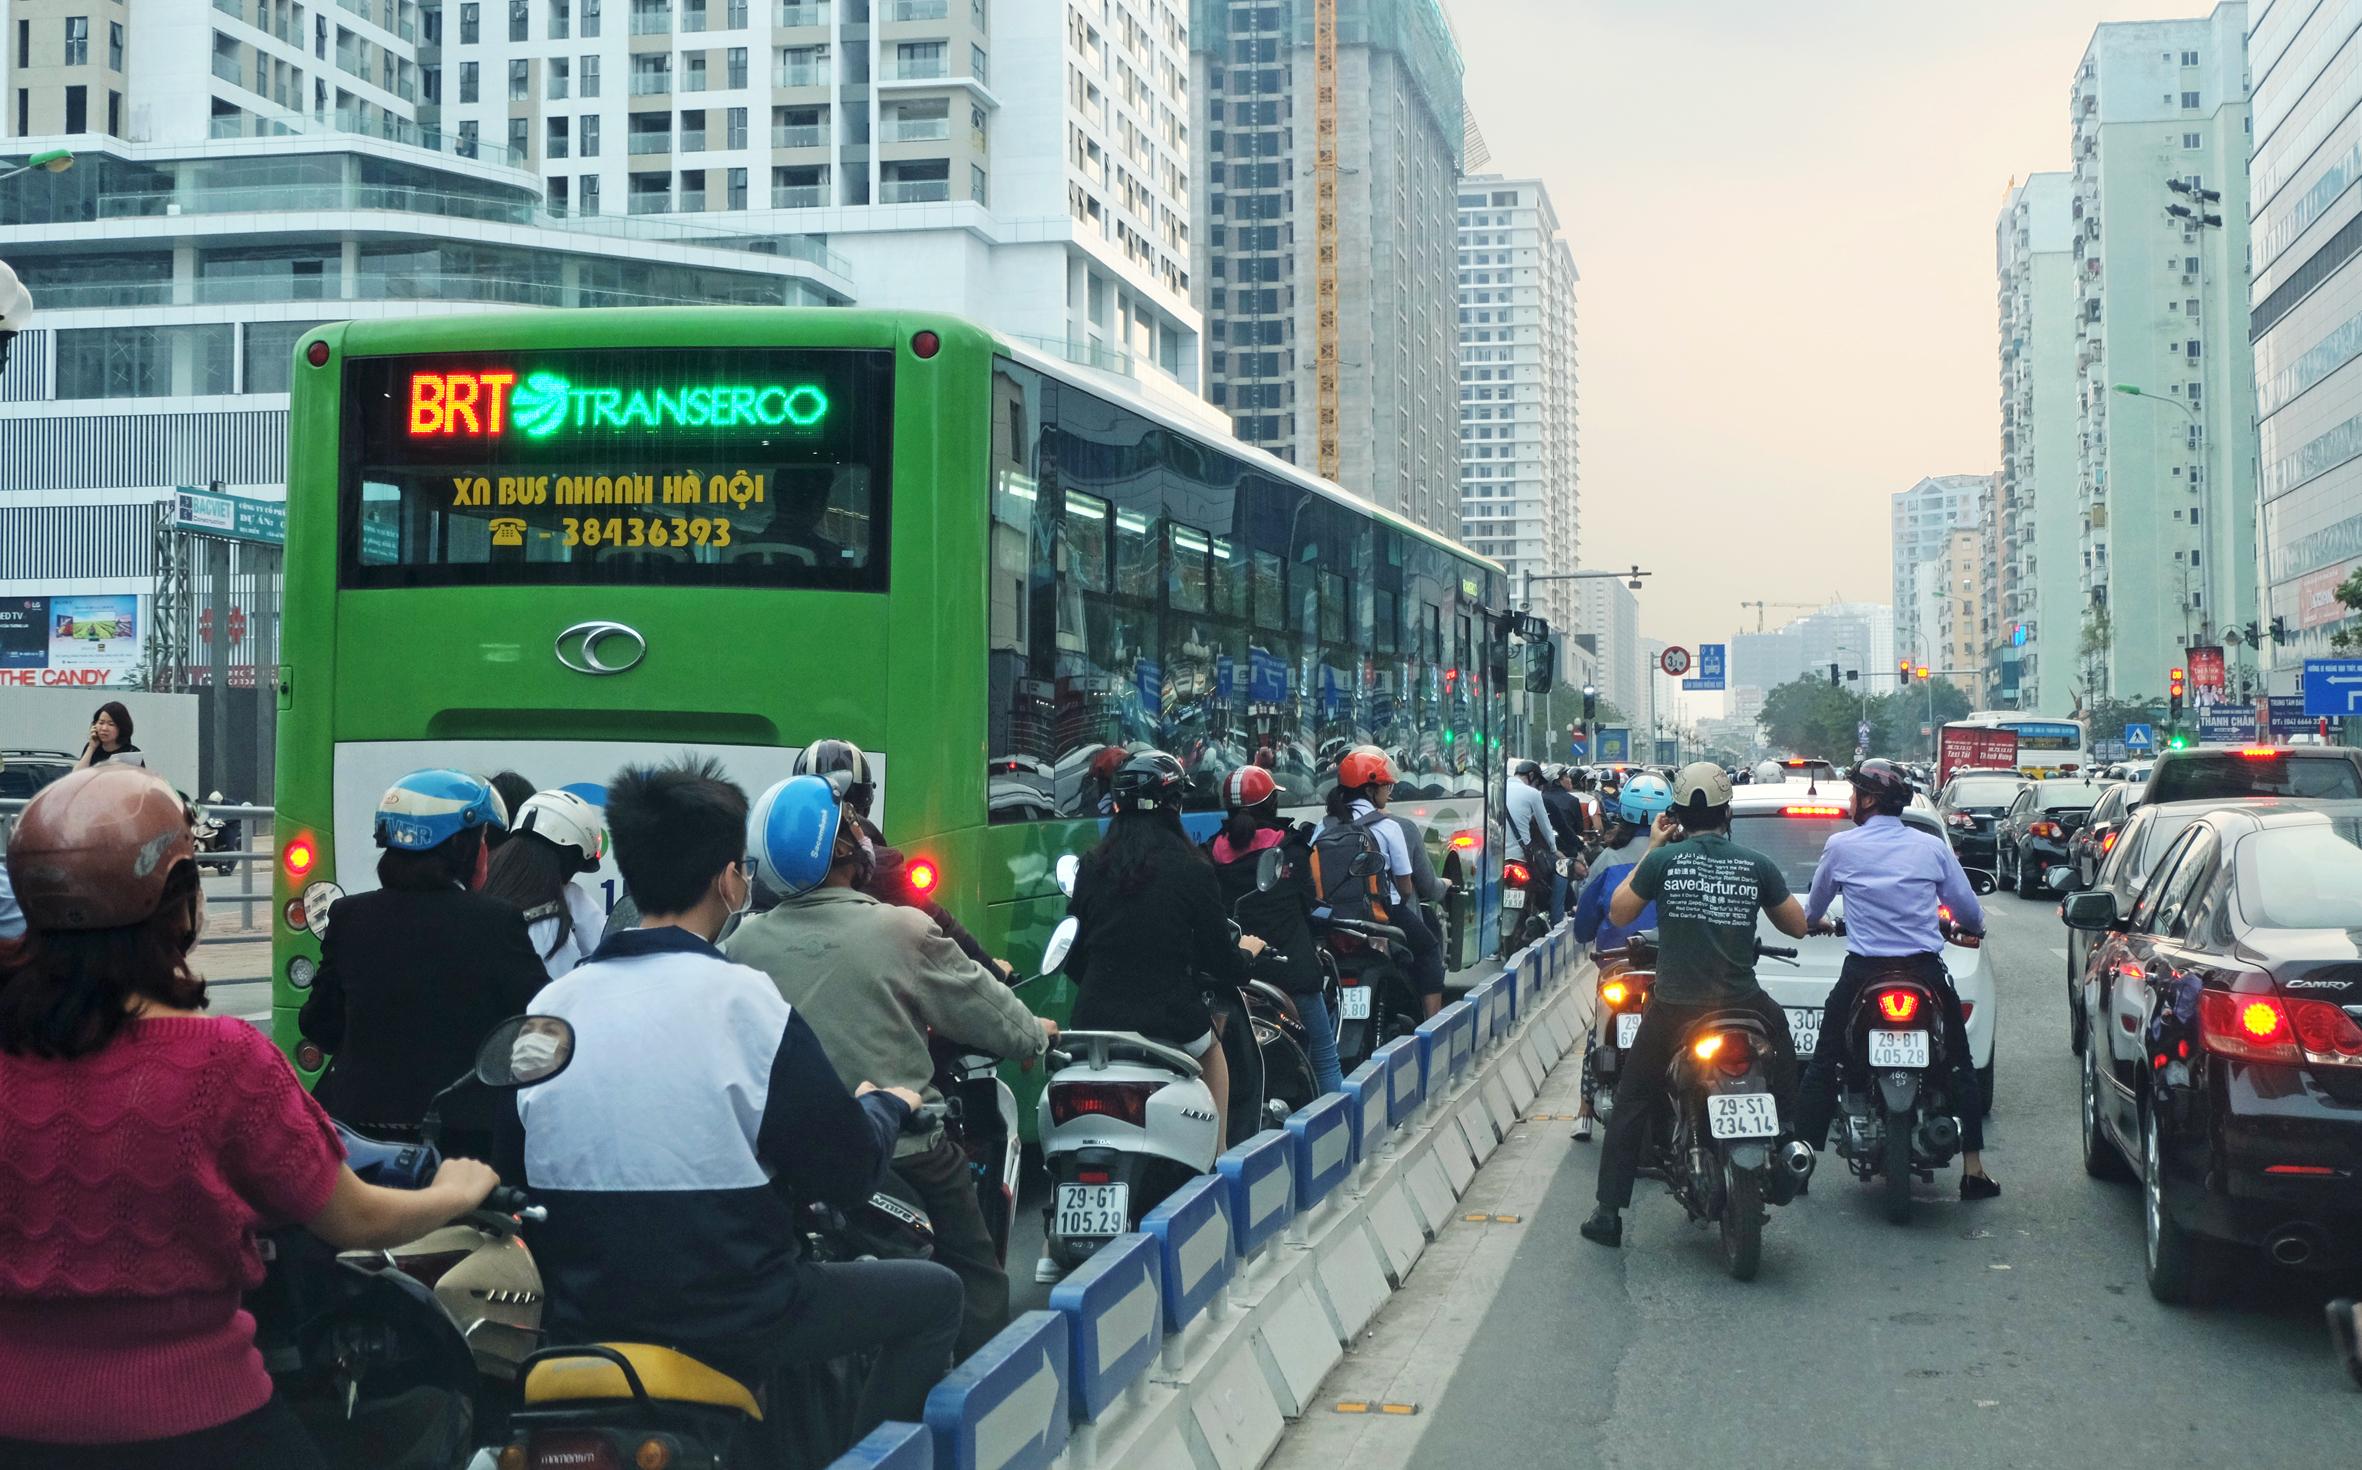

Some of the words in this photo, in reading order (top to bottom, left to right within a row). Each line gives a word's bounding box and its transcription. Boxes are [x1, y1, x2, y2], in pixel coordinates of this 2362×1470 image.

[410, 374, 514, 433] BRT
[568, 385, 828, 427] TRANSERCO
[452, 477, 491, 506] XN
[498, 476, 549, 505] BUS
[555, 475, 653, 505] NHANH
[662, 469, 701, 504] HÀ
[709, 469, 764, 511] NỘI
[562, 517, 731, 547] 38436393
[0, 669, 36, 686] THE
[41, 669, 111, 686] CANDY
[2201, 717, 2228, 726] THANH
[2231, 714, 2255, 726] CHÂN
[1664, 878, 1758, 900] savedarfur.org
[2285, 980, 2354, 990] CAMRY
[1878, 1032, 1919, 1047] 29-B1
[1874, 1049, 1925, 1064] 405.28
[1718, 1098, 1764, 1115] 29-S1
[1715, 1116, 1773, 1134] 234.14
[1066, 1187, 1117, 1209] 29-G1
[1061, 1211, 1121, 1233] 105.29
